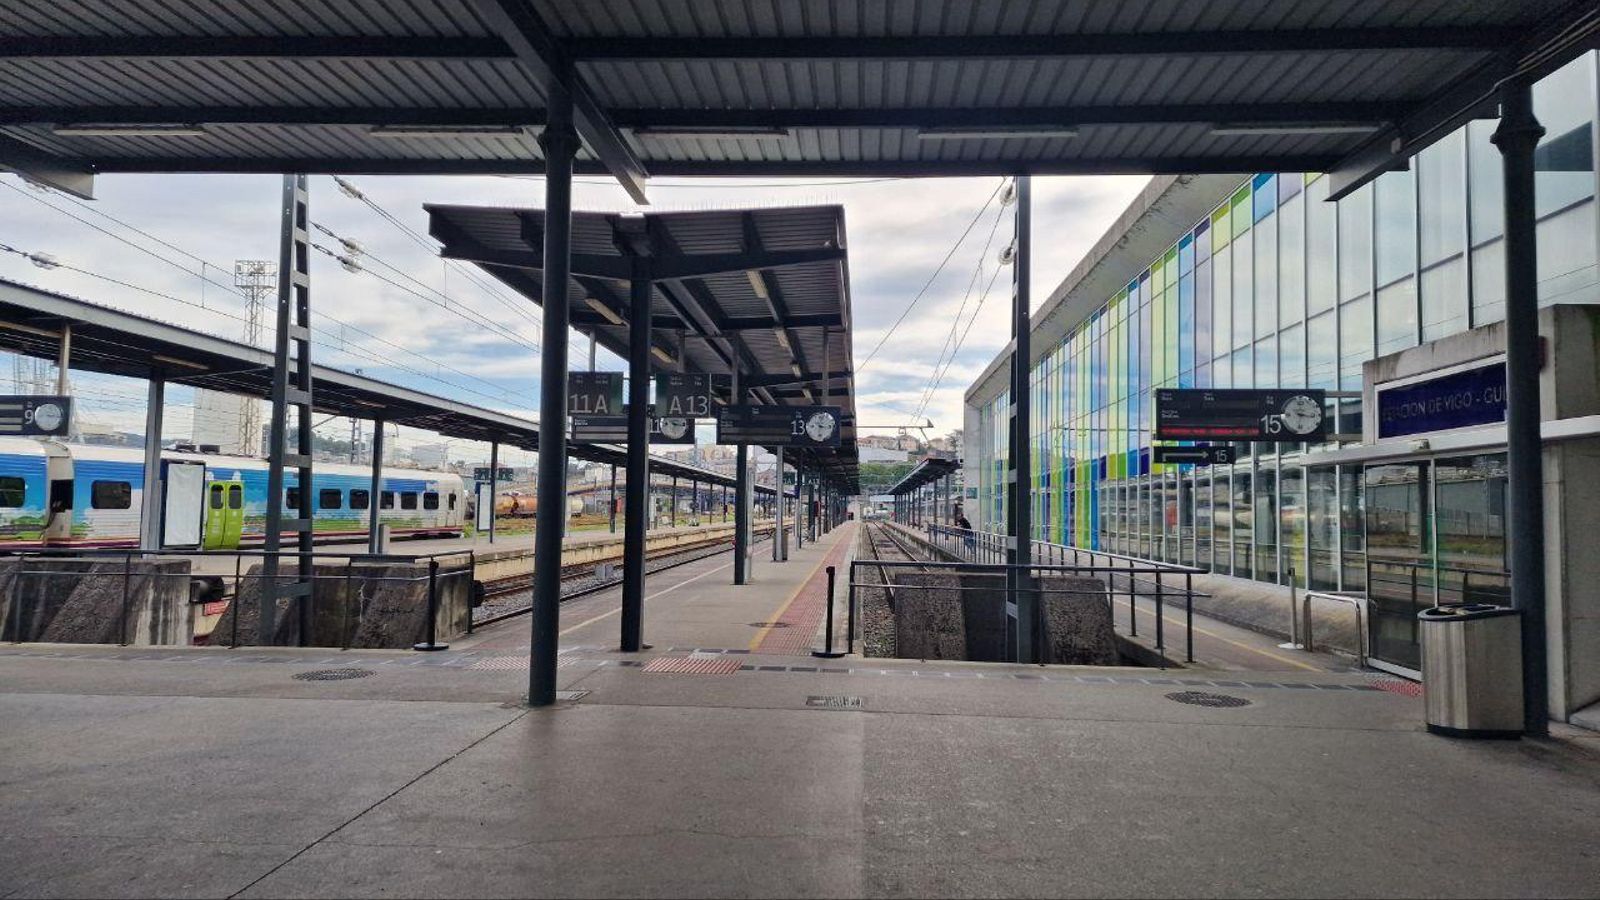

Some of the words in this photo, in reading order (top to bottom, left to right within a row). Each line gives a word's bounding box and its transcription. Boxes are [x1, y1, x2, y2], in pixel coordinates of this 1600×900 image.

[570, 393, 592, 414] 11
[594, 394, 608, 414] A
[669, 395, 682, 415] A
[685, 395, 709, 415] 13
[1428, 397, 1442, 414] DE
[1444, 391, 1472, 410] VIGO
[24, 409, 34, 425] 9
[791, 419, 806, 435] 13
[1261, 414, 1281, 434] 15
[1214, 450, 1227, 462] 15
